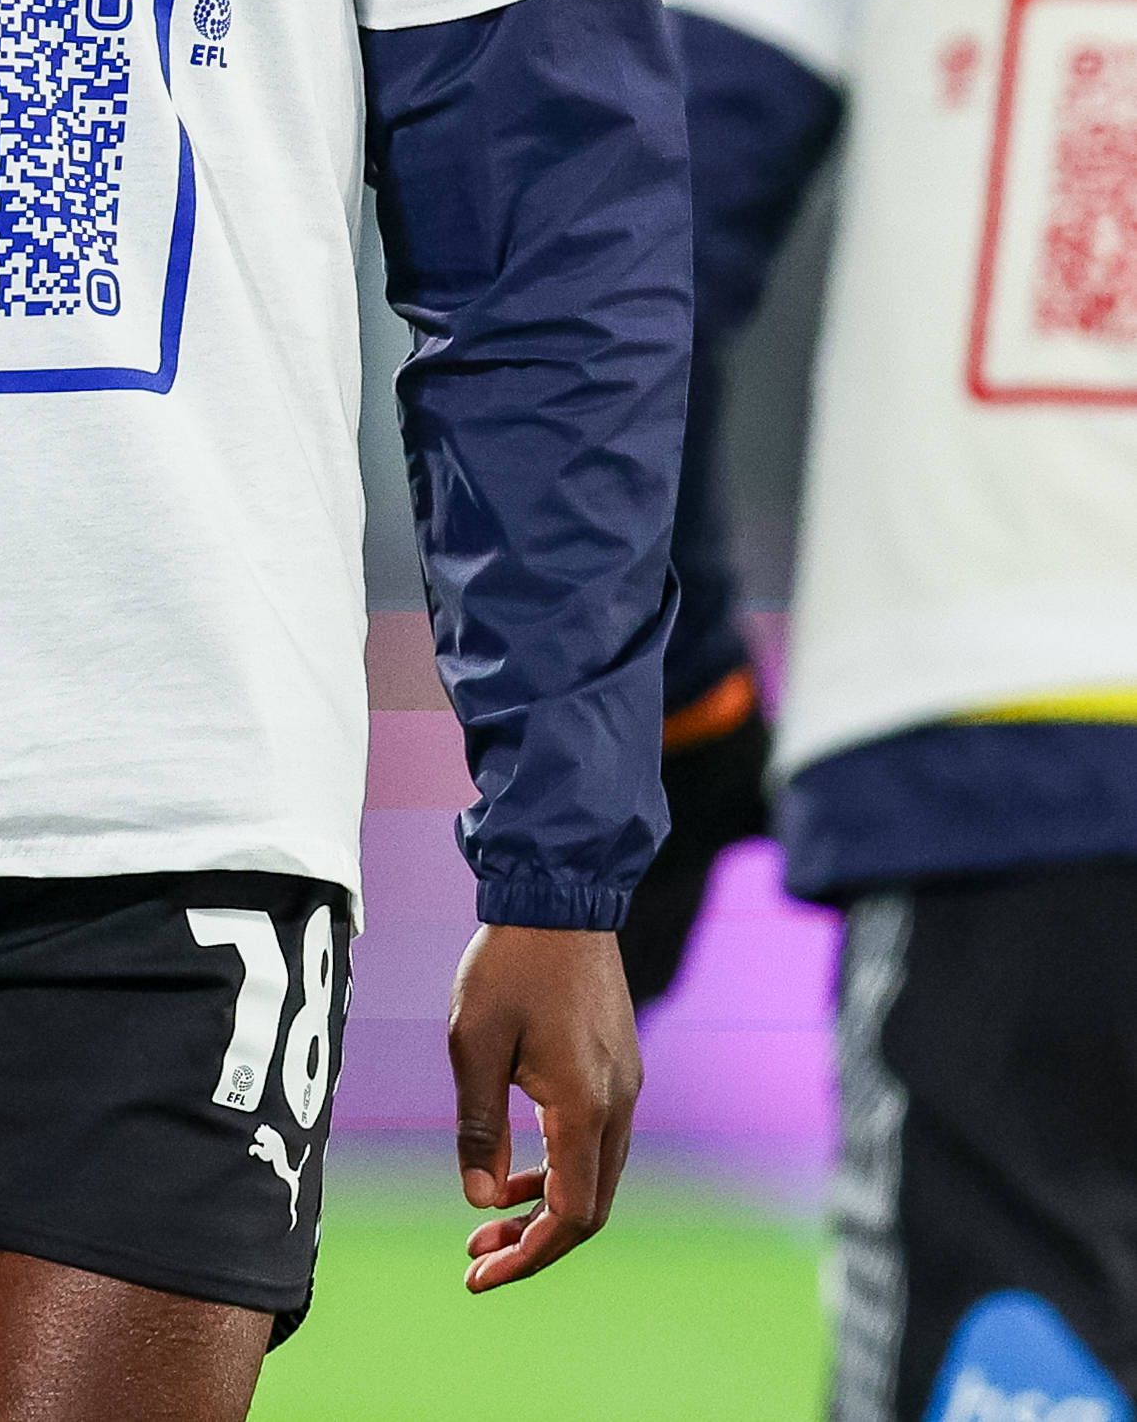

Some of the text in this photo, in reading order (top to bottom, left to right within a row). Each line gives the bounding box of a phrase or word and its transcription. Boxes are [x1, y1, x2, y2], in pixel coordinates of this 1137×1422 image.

[190, 44, 228, 68] EFL
[185, 904, 333, 1129] 78
[226, 1091, 246, 1106] EFL
